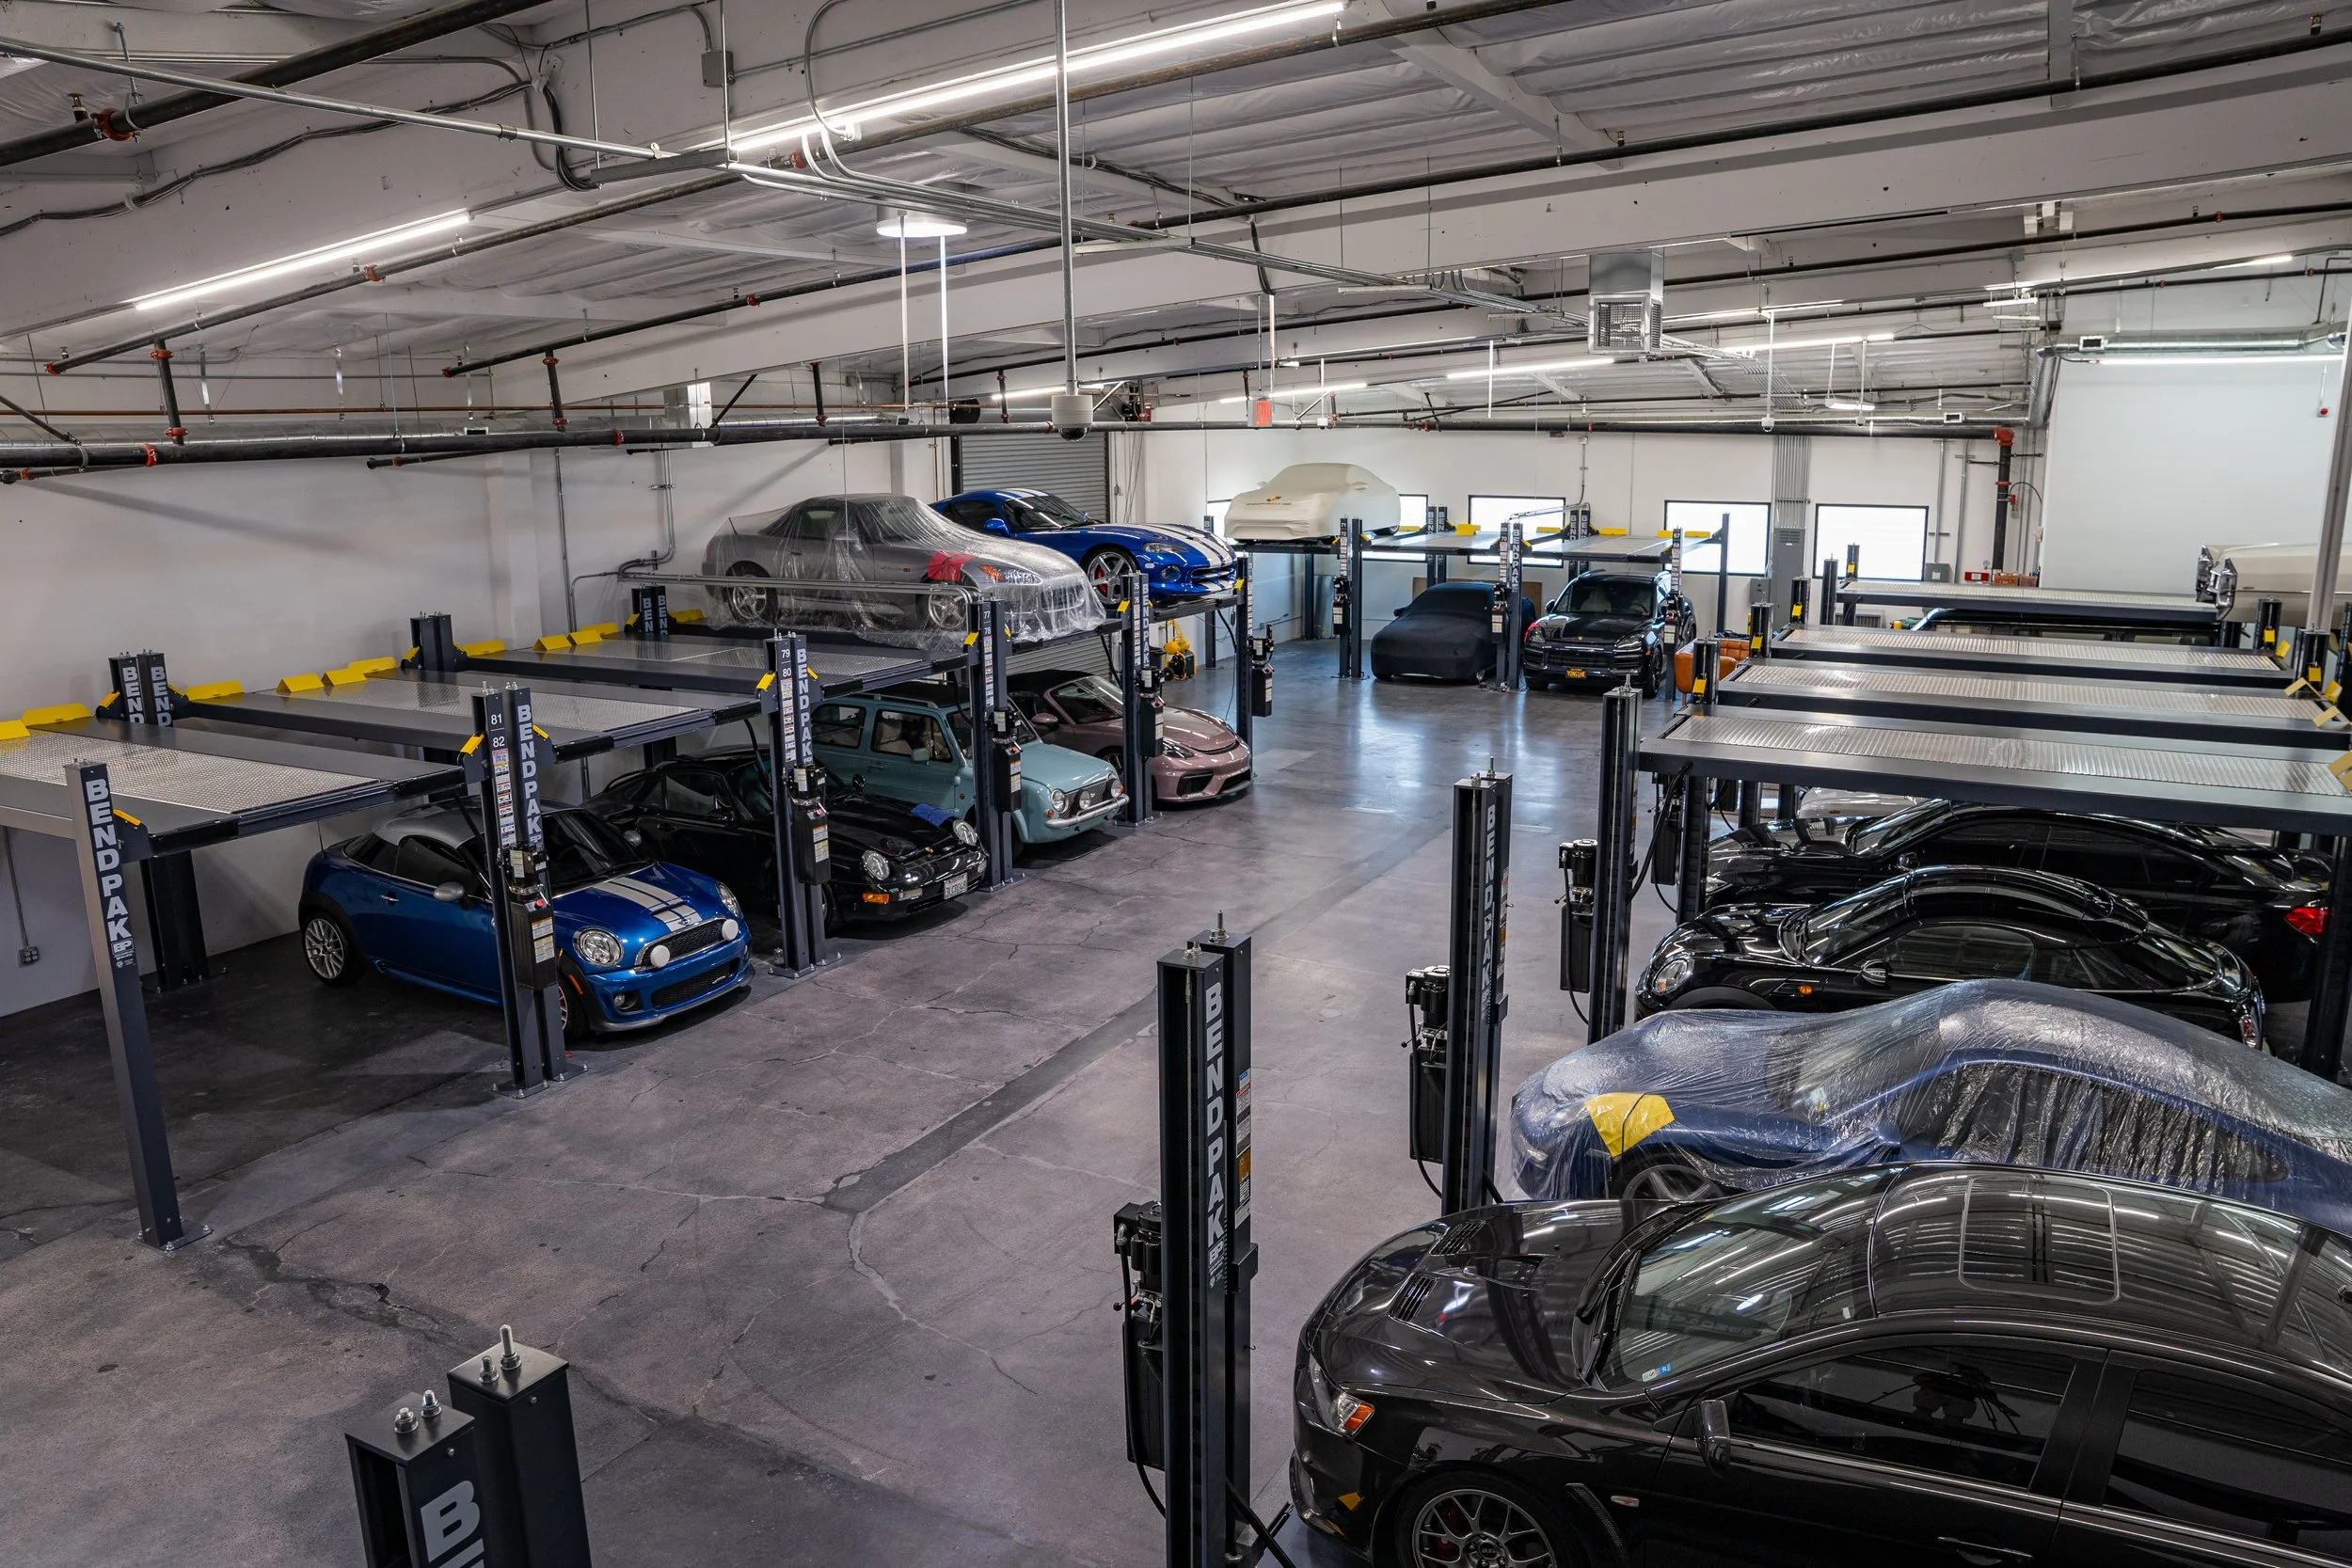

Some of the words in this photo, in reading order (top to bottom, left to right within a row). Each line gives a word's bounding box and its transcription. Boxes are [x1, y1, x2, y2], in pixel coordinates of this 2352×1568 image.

[1511, 529, 1520, 583] BENDPAK
[983, 610, 991, 619] 77
[781, 649, 790, 658] 79
[782, 667, 791, 677] 80
[490, 713, 503, 725] 81
[797, 648, 812, 756] BENDPAK
[492, 736, 505, 749] 82
[517, 704, 542, 835] BENDPAK
[86, 778, 133, 942] BENDPAK
[1481, 804, 1496, 992] BENDPAK
[1204, 981, 1224, 1248] BENDPAK
